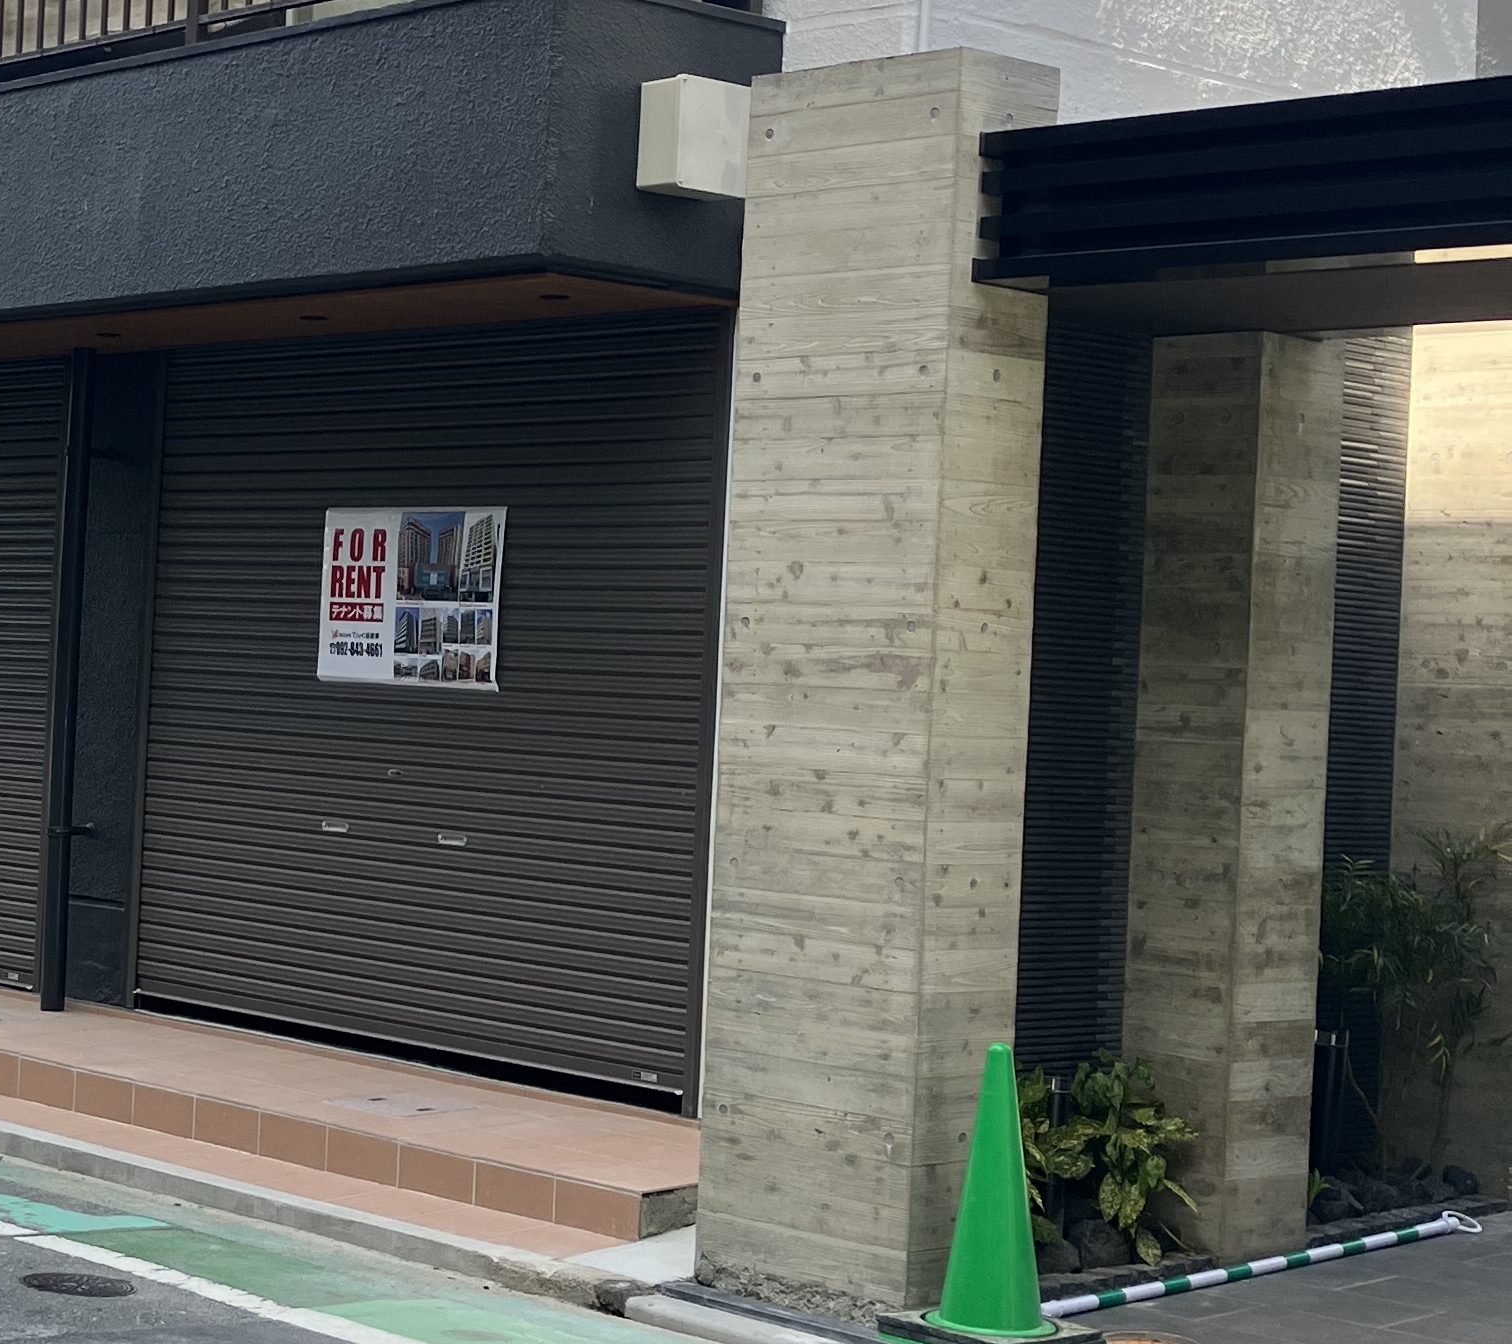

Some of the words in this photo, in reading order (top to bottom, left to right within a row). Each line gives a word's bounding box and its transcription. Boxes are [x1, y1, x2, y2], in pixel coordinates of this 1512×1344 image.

[332, 528, 387, 562] FOR
[330, 565, 385, 599] RENT
[331, 604, 383, 620] テナント募集
